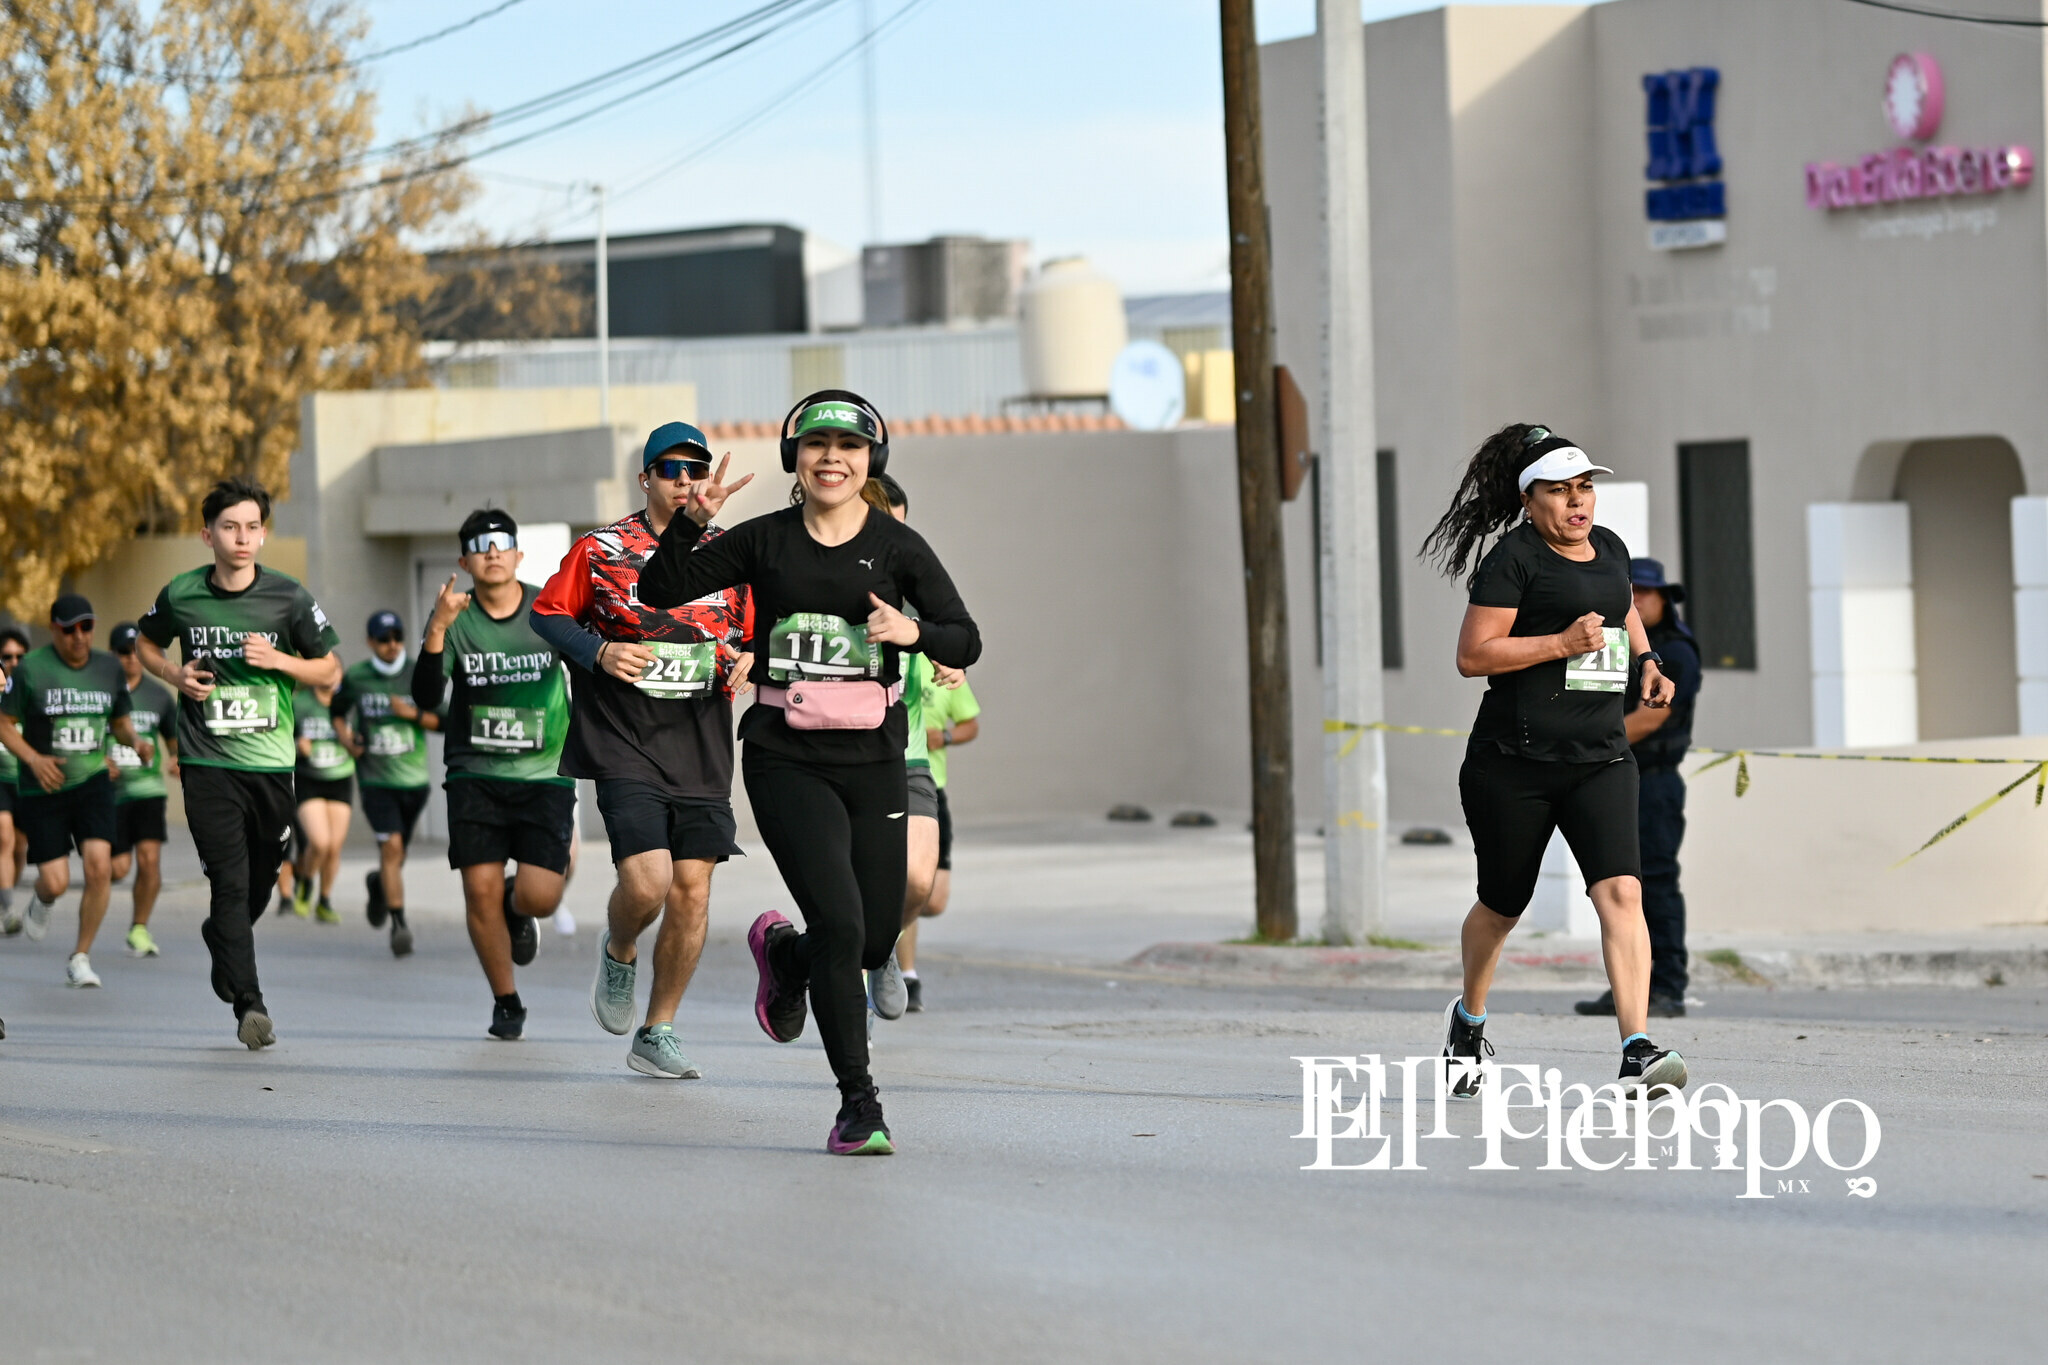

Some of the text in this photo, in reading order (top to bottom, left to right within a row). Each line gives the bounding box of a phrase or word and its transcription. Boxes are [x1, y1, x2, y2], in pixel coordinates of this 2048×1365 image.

[190, 626, 207, 645] El
[213, 646, 243, 659] tod
[786, 632, 851, 666] 112
[869, 642, 880, 678] MEDALL
[1579, 645, 1627, 671] 215
[464, 651, 552, 674] El Tiempo
[645, 659, 700, 682] 247
[707, 655, 717, 690] MEDALLA
[467, 671, 542, 687] de todos
[63, 688, 111, 707] Tiempo
[45, 703, 104, 715] de todos
[212, 699, 259, 720] 142
[481, 718, 525, 740] 144
